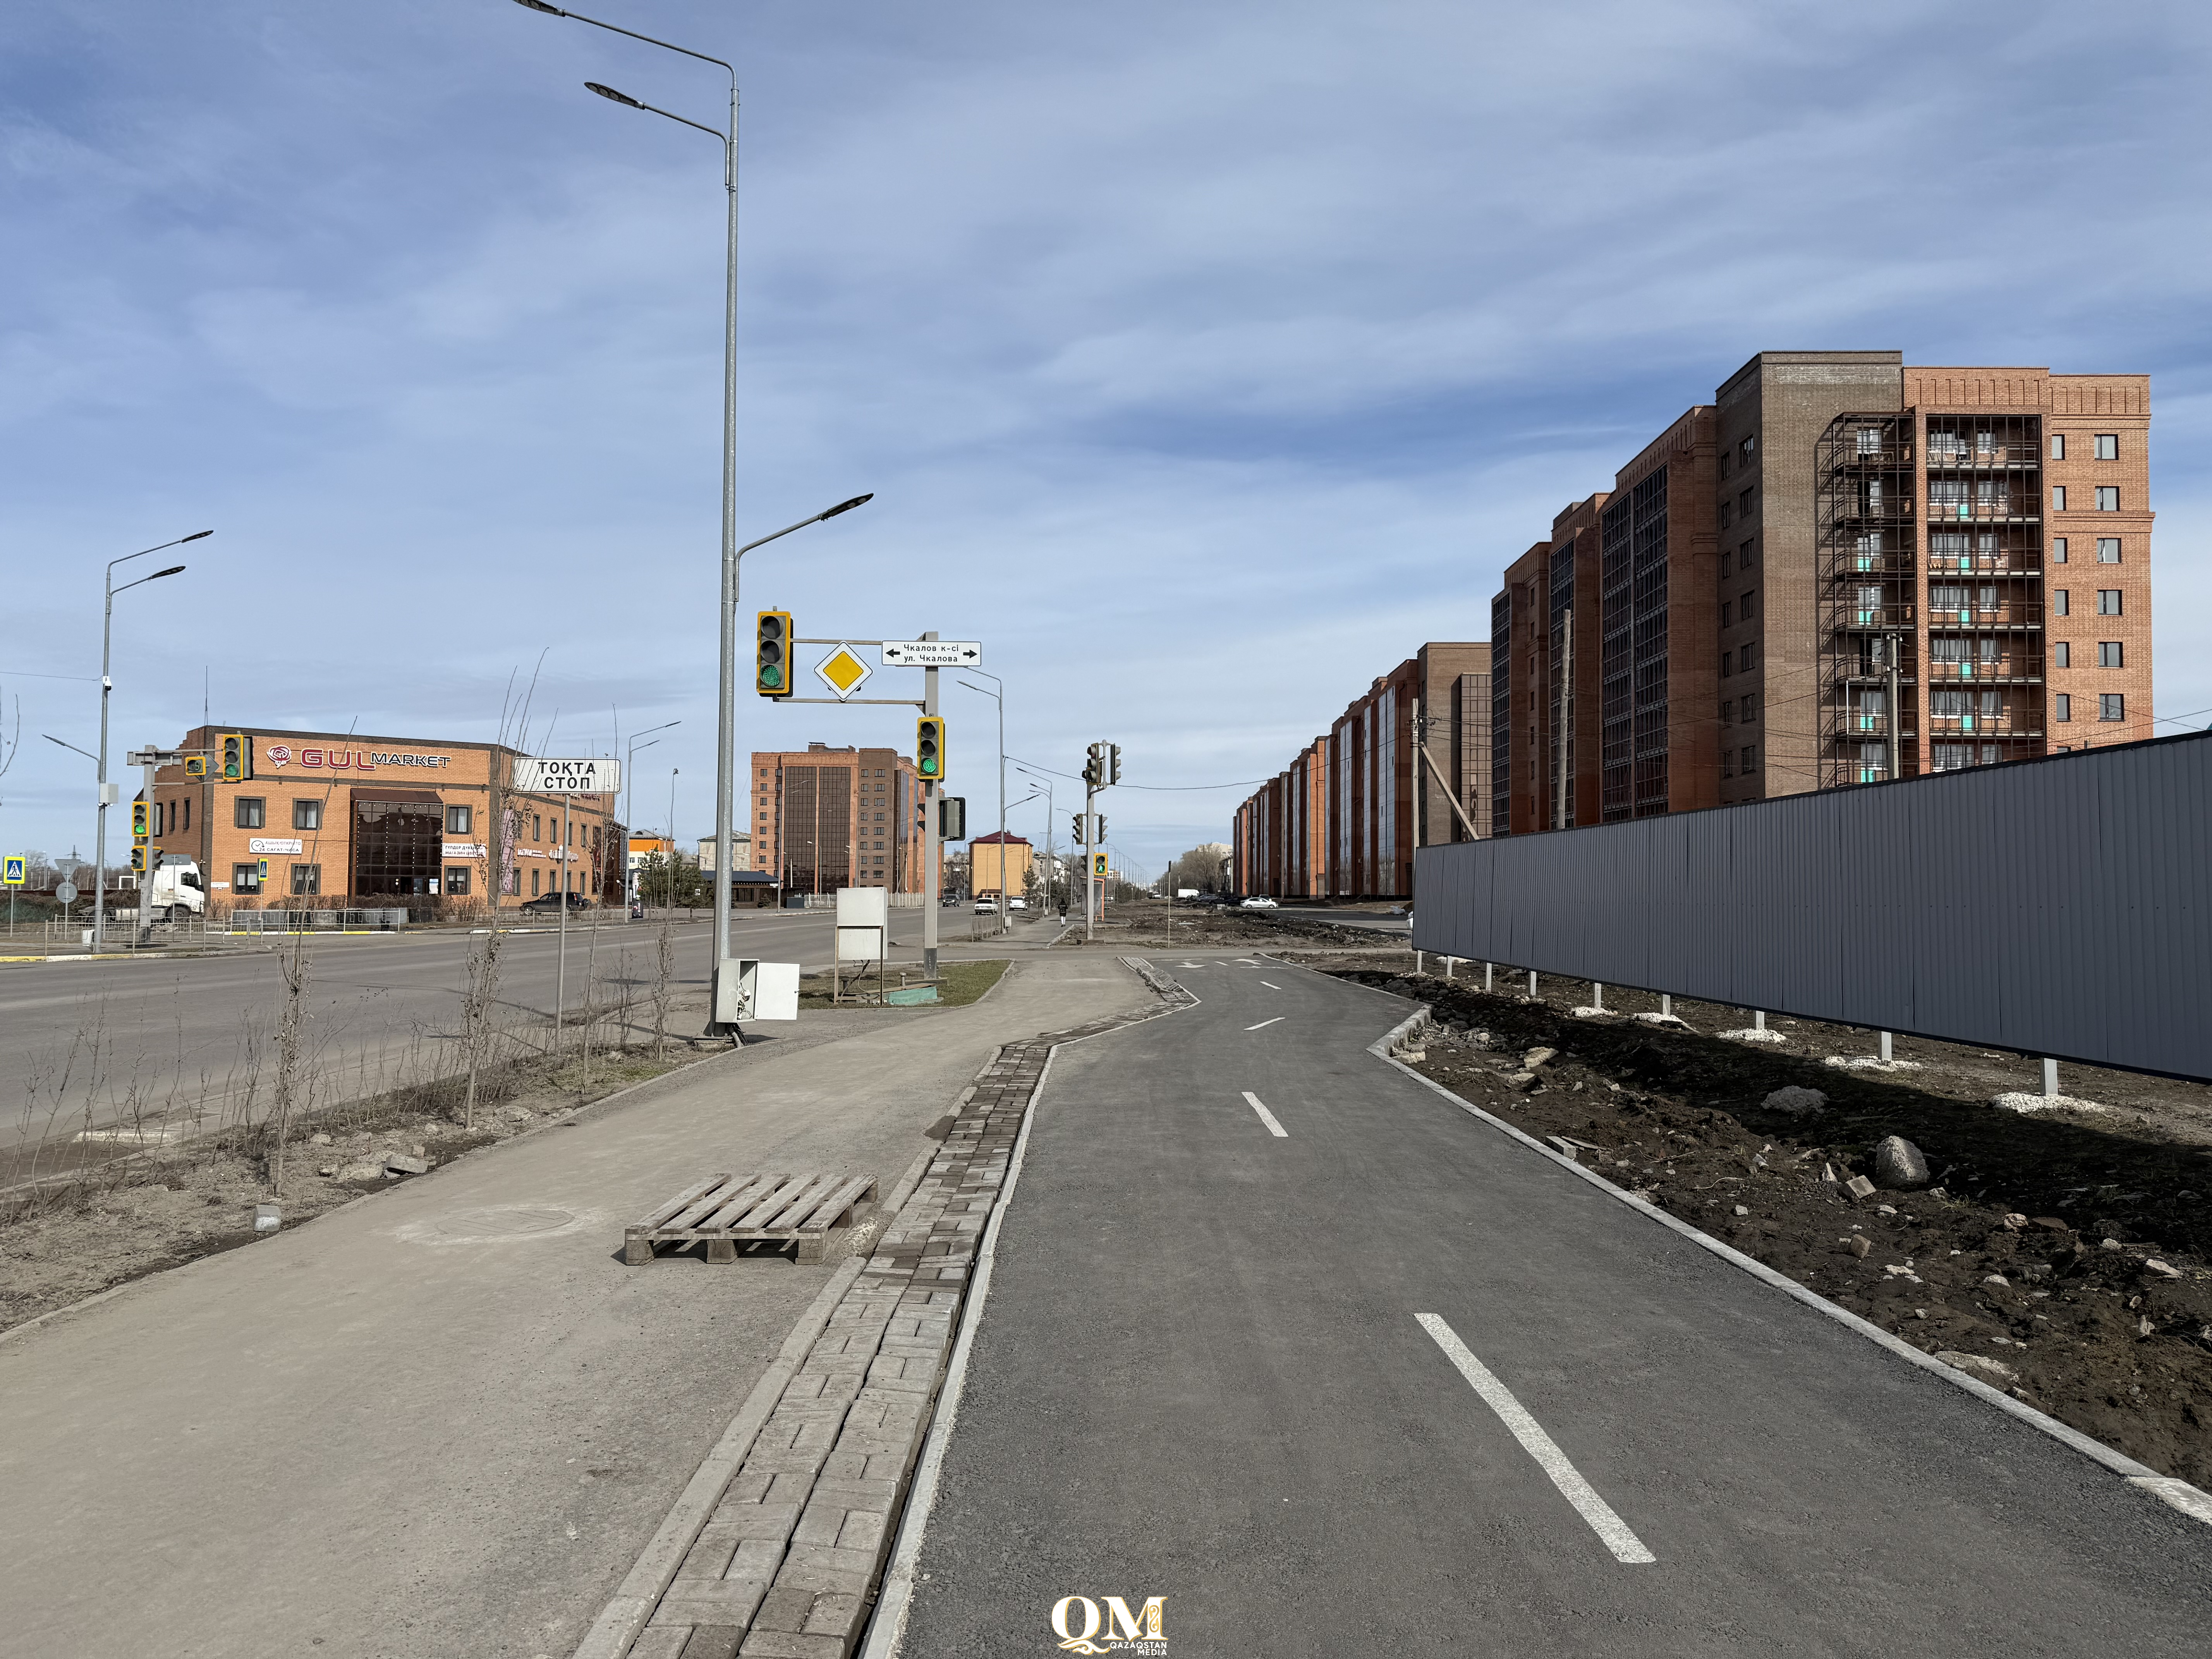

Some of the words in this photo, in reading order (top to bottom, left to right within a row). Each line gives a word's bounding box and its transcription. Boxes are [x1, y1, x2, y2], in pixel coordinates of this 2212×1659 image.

[301, 748, 376, 770] GUL
[371, 752, 452, 768] MARKET
[538, 762, 596, 776] ТОҚТА
[544, 777, 590, 789] СТОП
